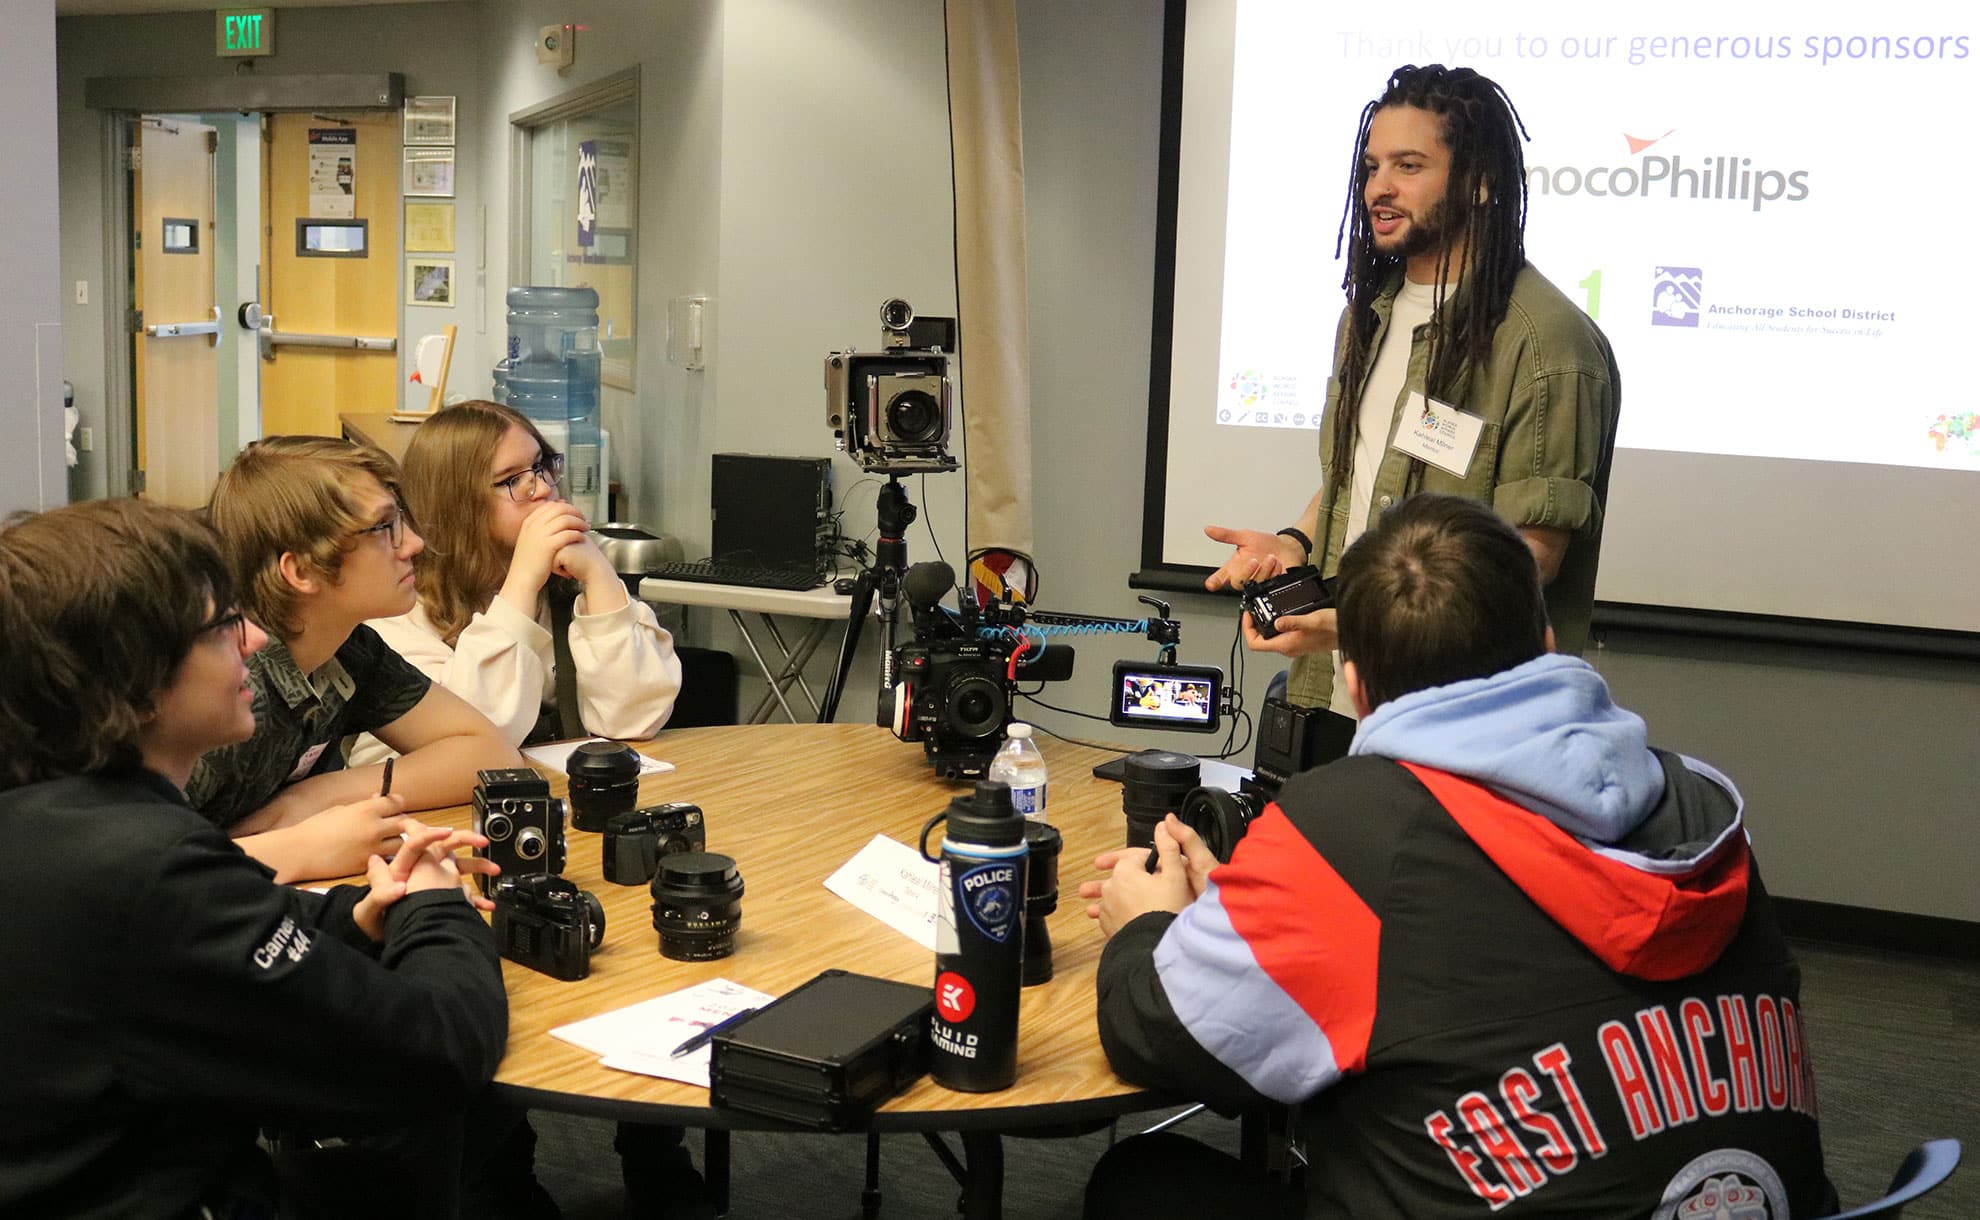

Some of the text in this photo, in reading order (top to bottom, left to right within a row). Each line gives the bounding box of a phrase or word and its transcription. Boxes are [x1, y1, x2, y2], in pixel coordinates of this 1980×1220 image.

[225, 14, 263, 50] EXIT
[1336, 28, 1970, 66] Thank you to our generous sponsors
[1708, 303, 1896, 322] Anchorage School District
[963, 869, 1014, 892] POLICE
[253, 915, 296, 969] Came
[1424, 994, 1818, 1211] EAST ANCHOR
